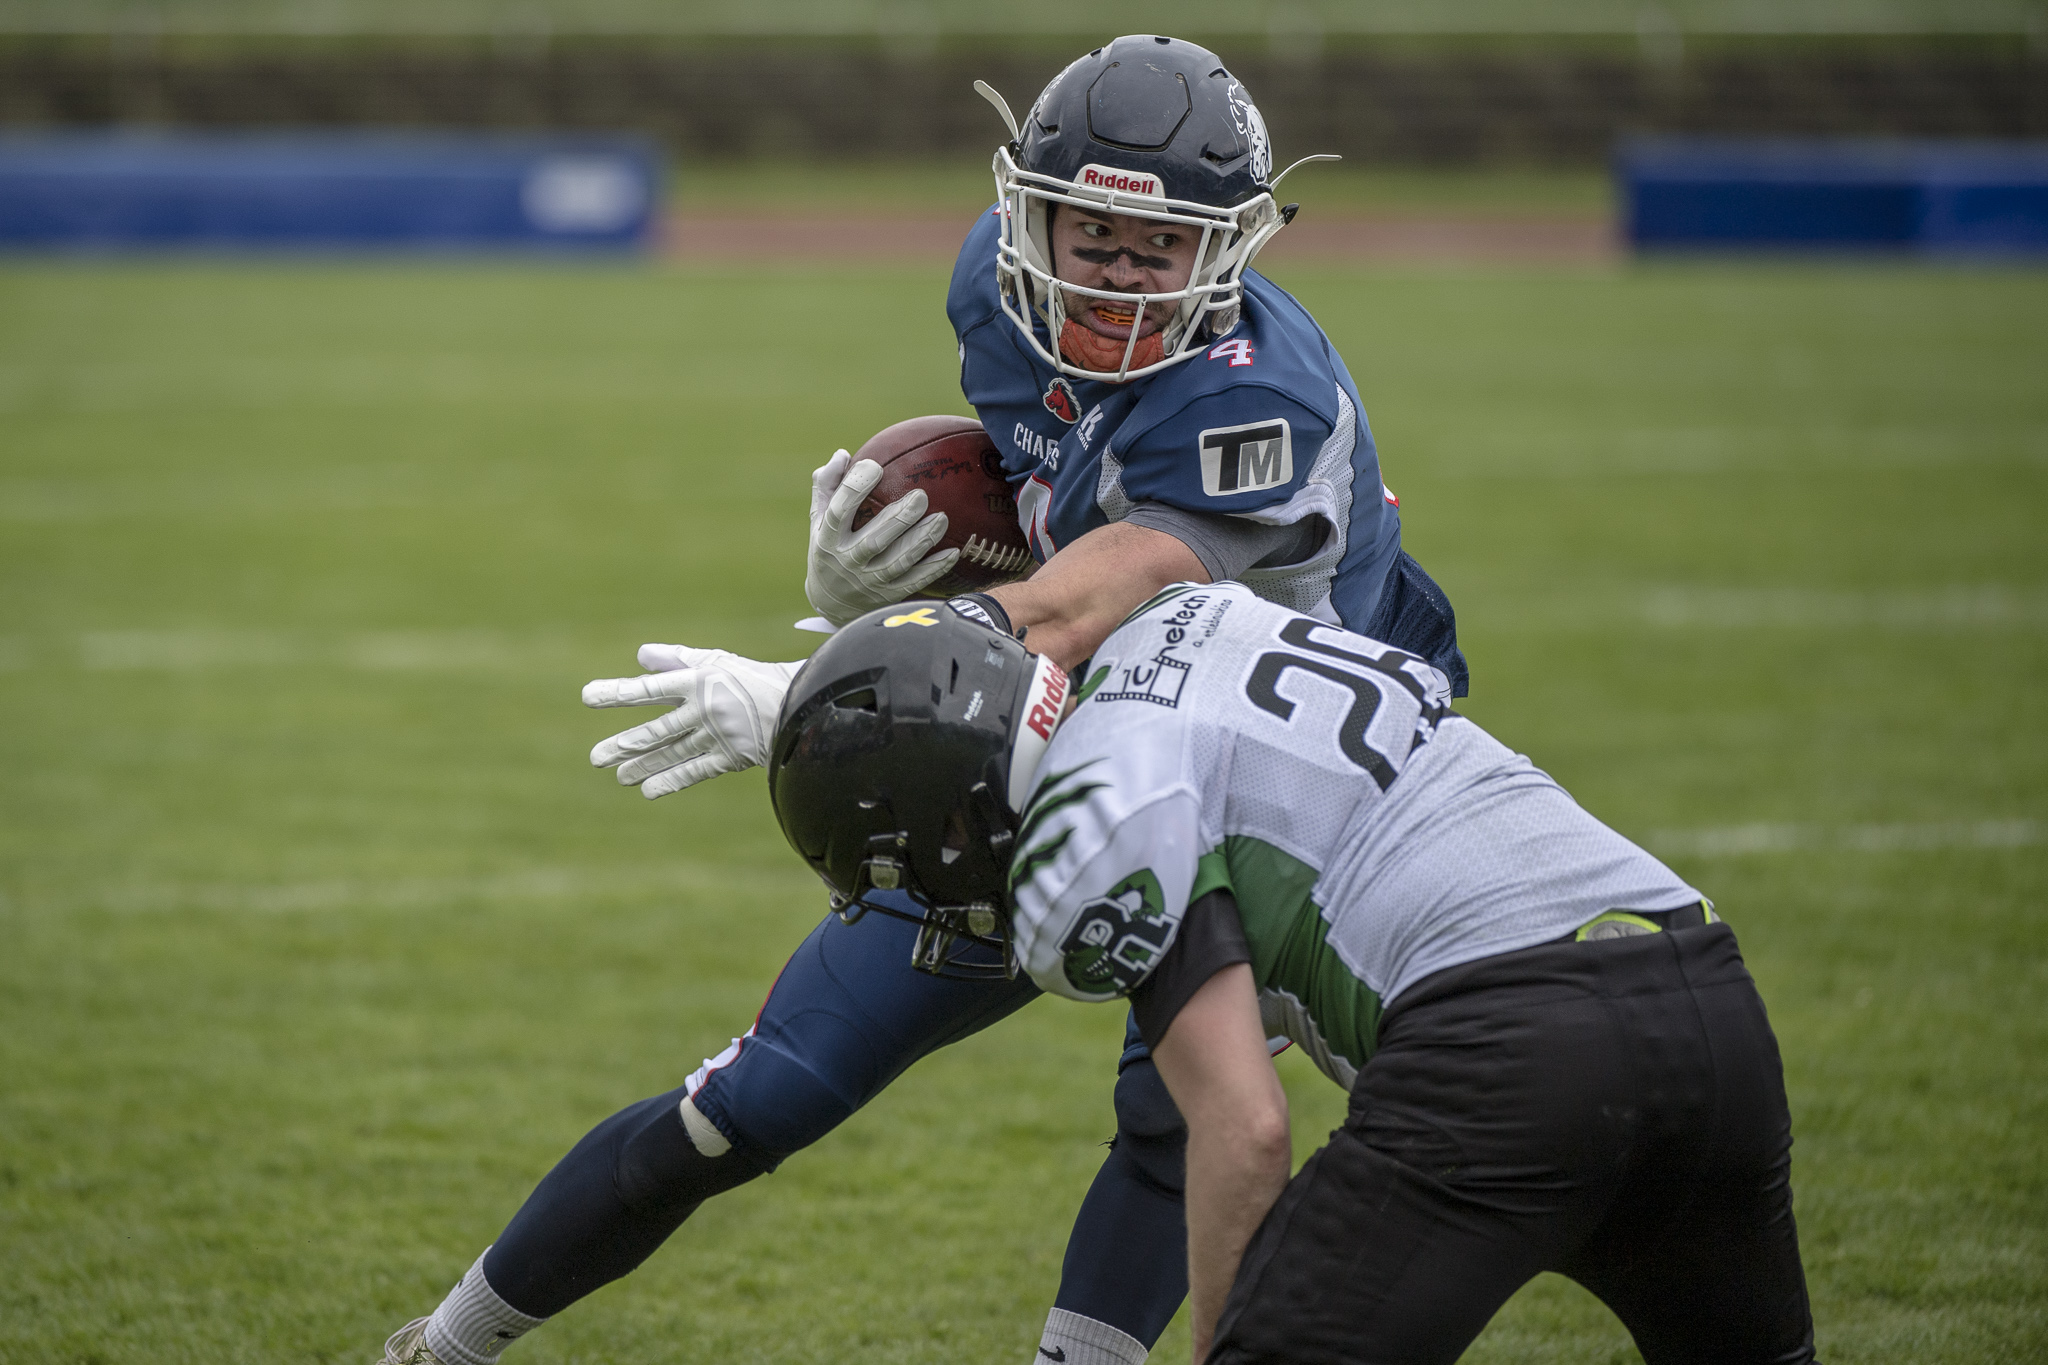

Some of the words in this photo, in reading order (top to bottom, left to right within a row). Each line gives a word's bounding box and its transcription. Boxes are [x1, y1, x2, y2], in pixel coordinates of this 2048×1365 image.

[1084, 169, 1155, 194] Riddell
[1208, 338, 1255, 368] 4
[1202, 423, 1284, 492] TM
[1026, 663, 1069, 742] Ridde
